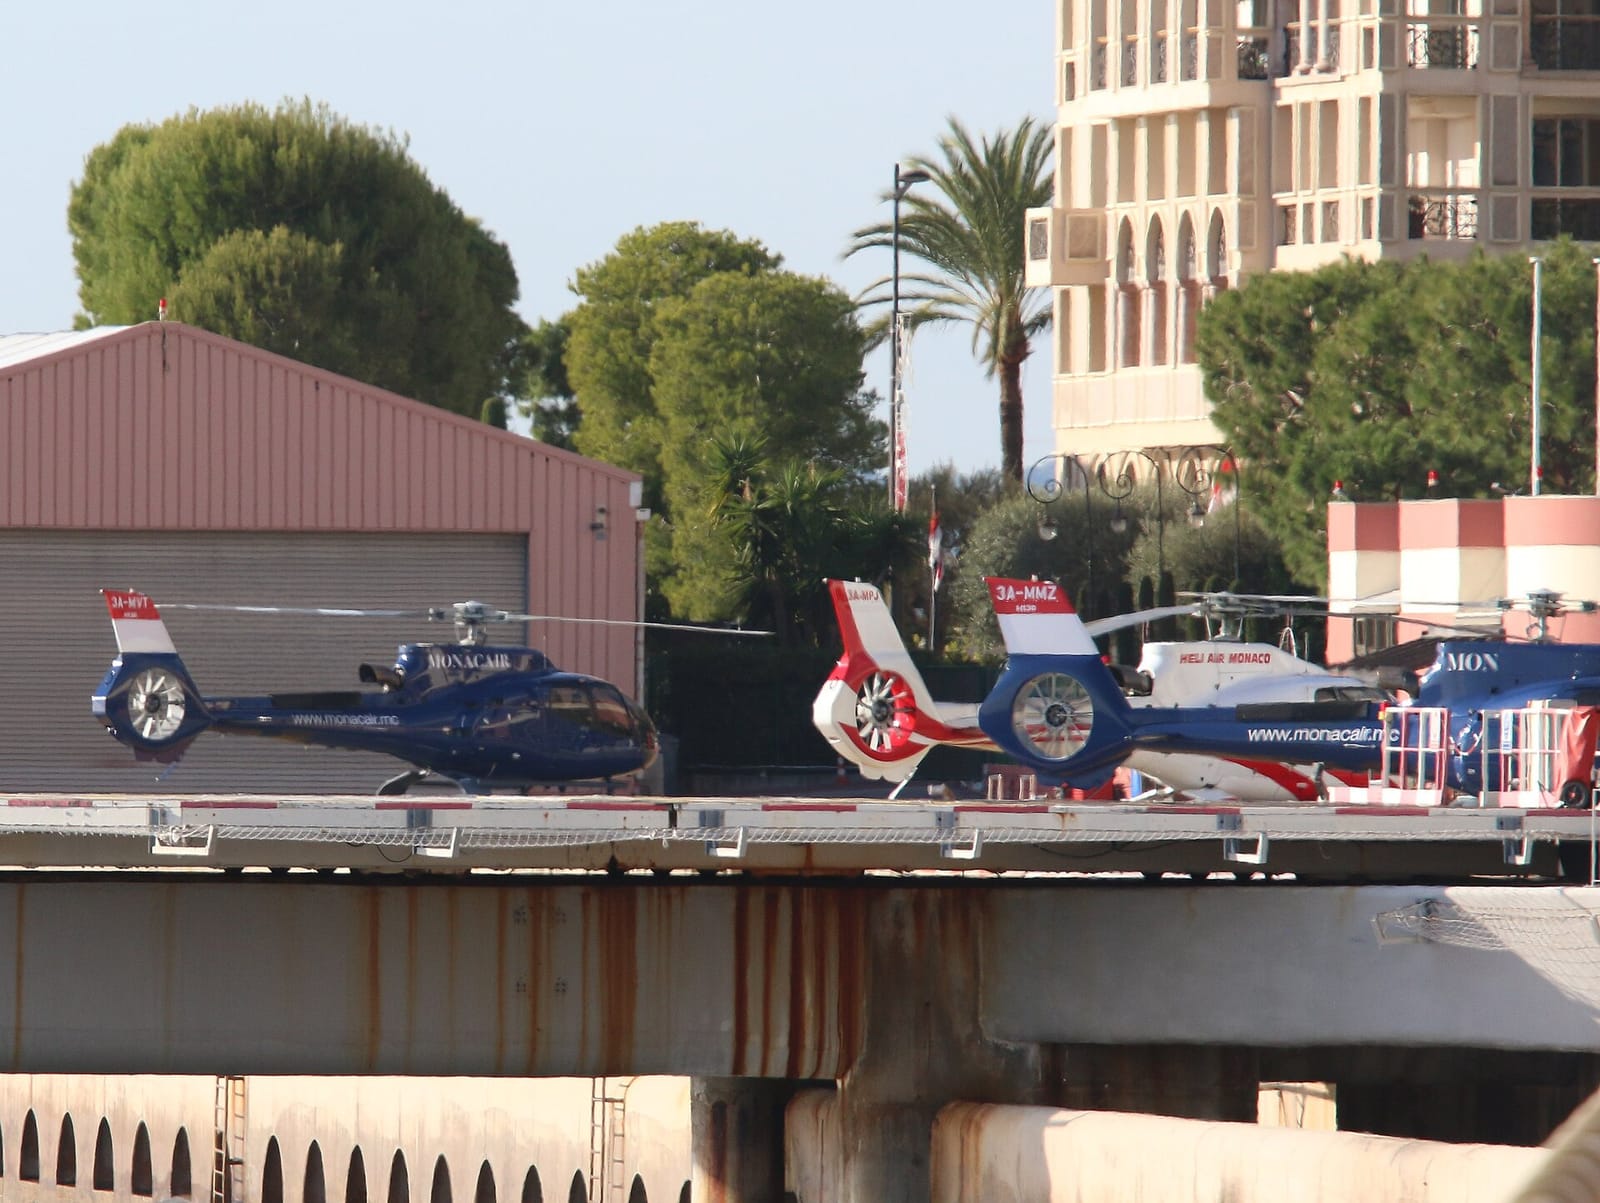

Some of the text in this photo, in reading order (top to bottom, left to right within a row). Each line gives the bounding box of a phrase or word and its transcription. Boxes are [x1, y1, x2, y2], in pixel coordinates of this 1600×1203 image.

[995, 585, 1057, 600] 3A-MMZ
[111, 596, 148, 608] 3A-MVT
[428, 653, 511, 669] MONACAIR
[1180, 653, 1271, 664] HELI AIR MONACO
[1447, 652, 1499, 671] MON
[291, 714, 400, 726] www.monacair.mc
[1248, 726, 1400, 742] www.monacair.mc
